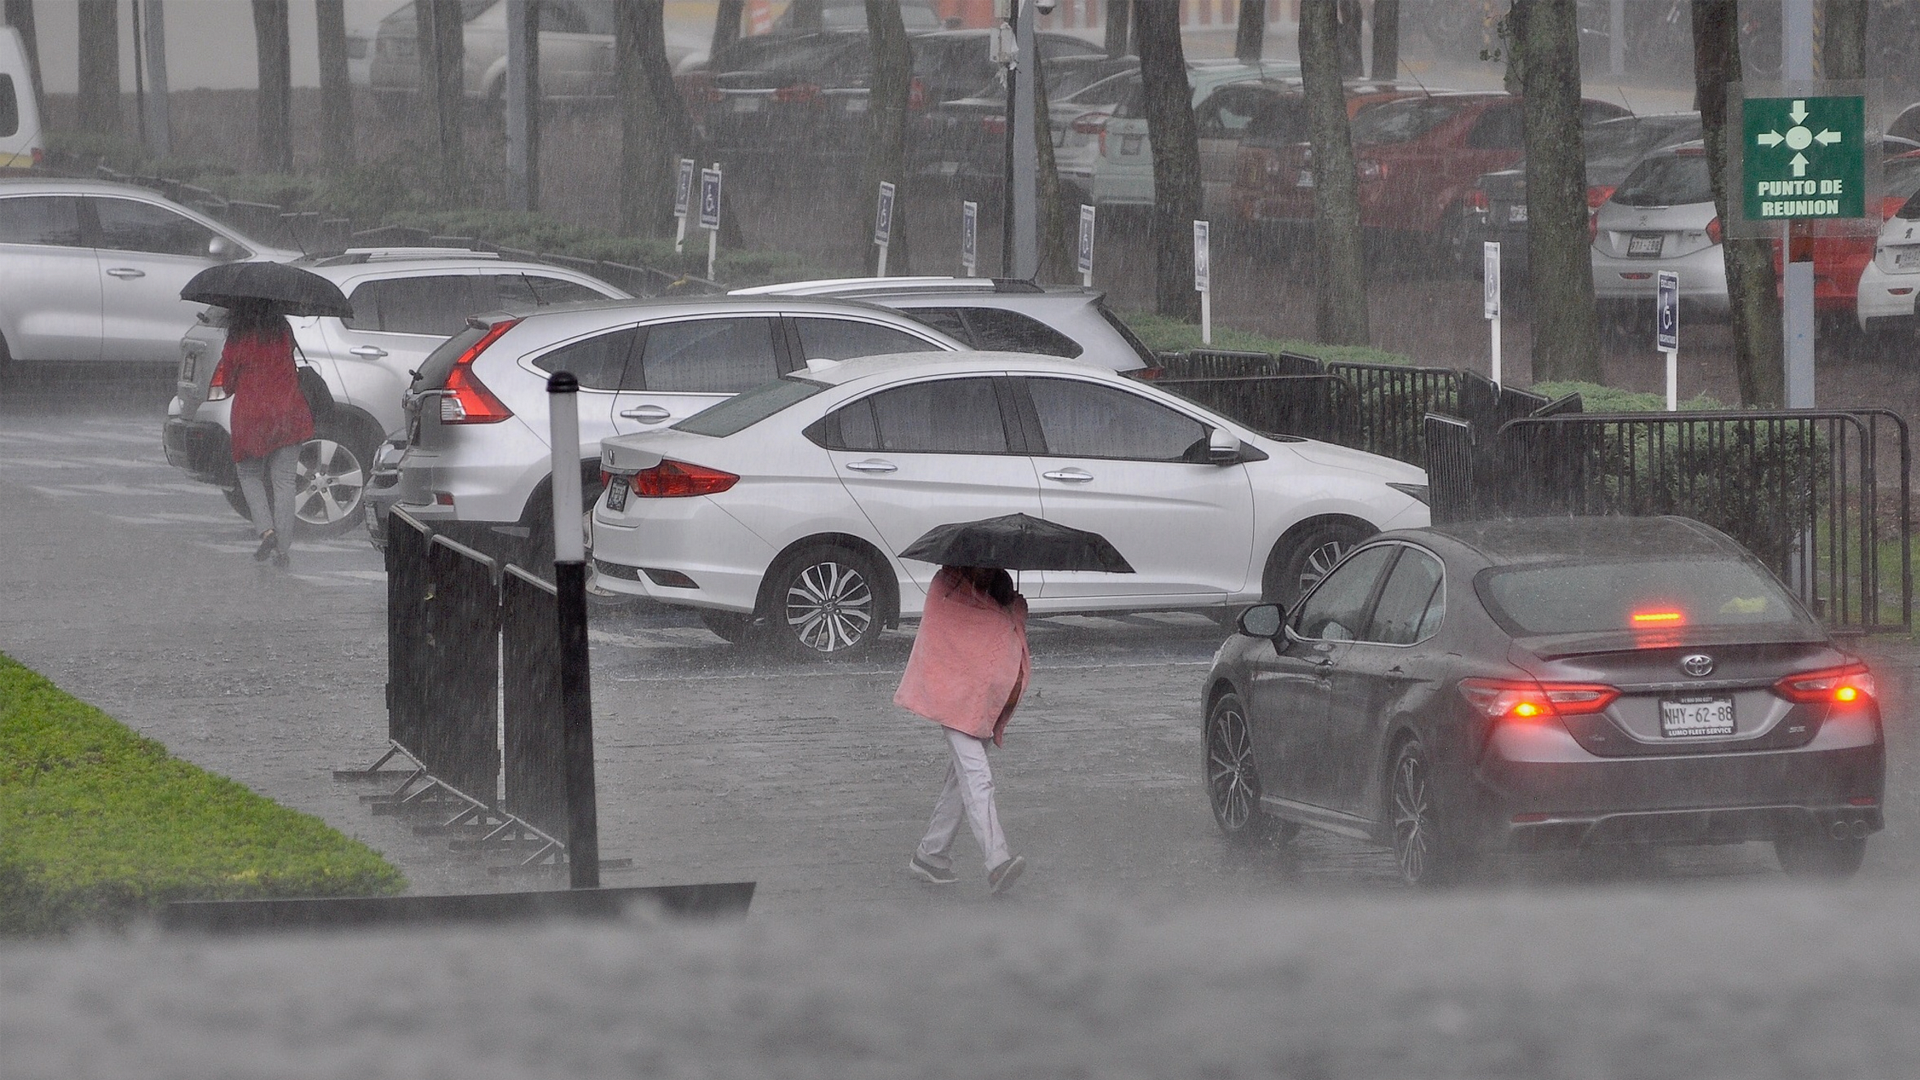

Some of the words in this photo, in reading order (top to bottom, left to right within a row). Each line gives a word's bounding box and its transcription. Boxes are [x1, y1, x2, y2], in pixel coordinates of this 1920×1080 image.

[1758, 180, 1816, 196] PUNTO
[1820, 180, 1843, 194] DE
[1762, 200, 1839, 216] REUNION
[1664, 706, 1733, 724] NHY-62-88
[1706, 727, 1732, 735] SERVICE
